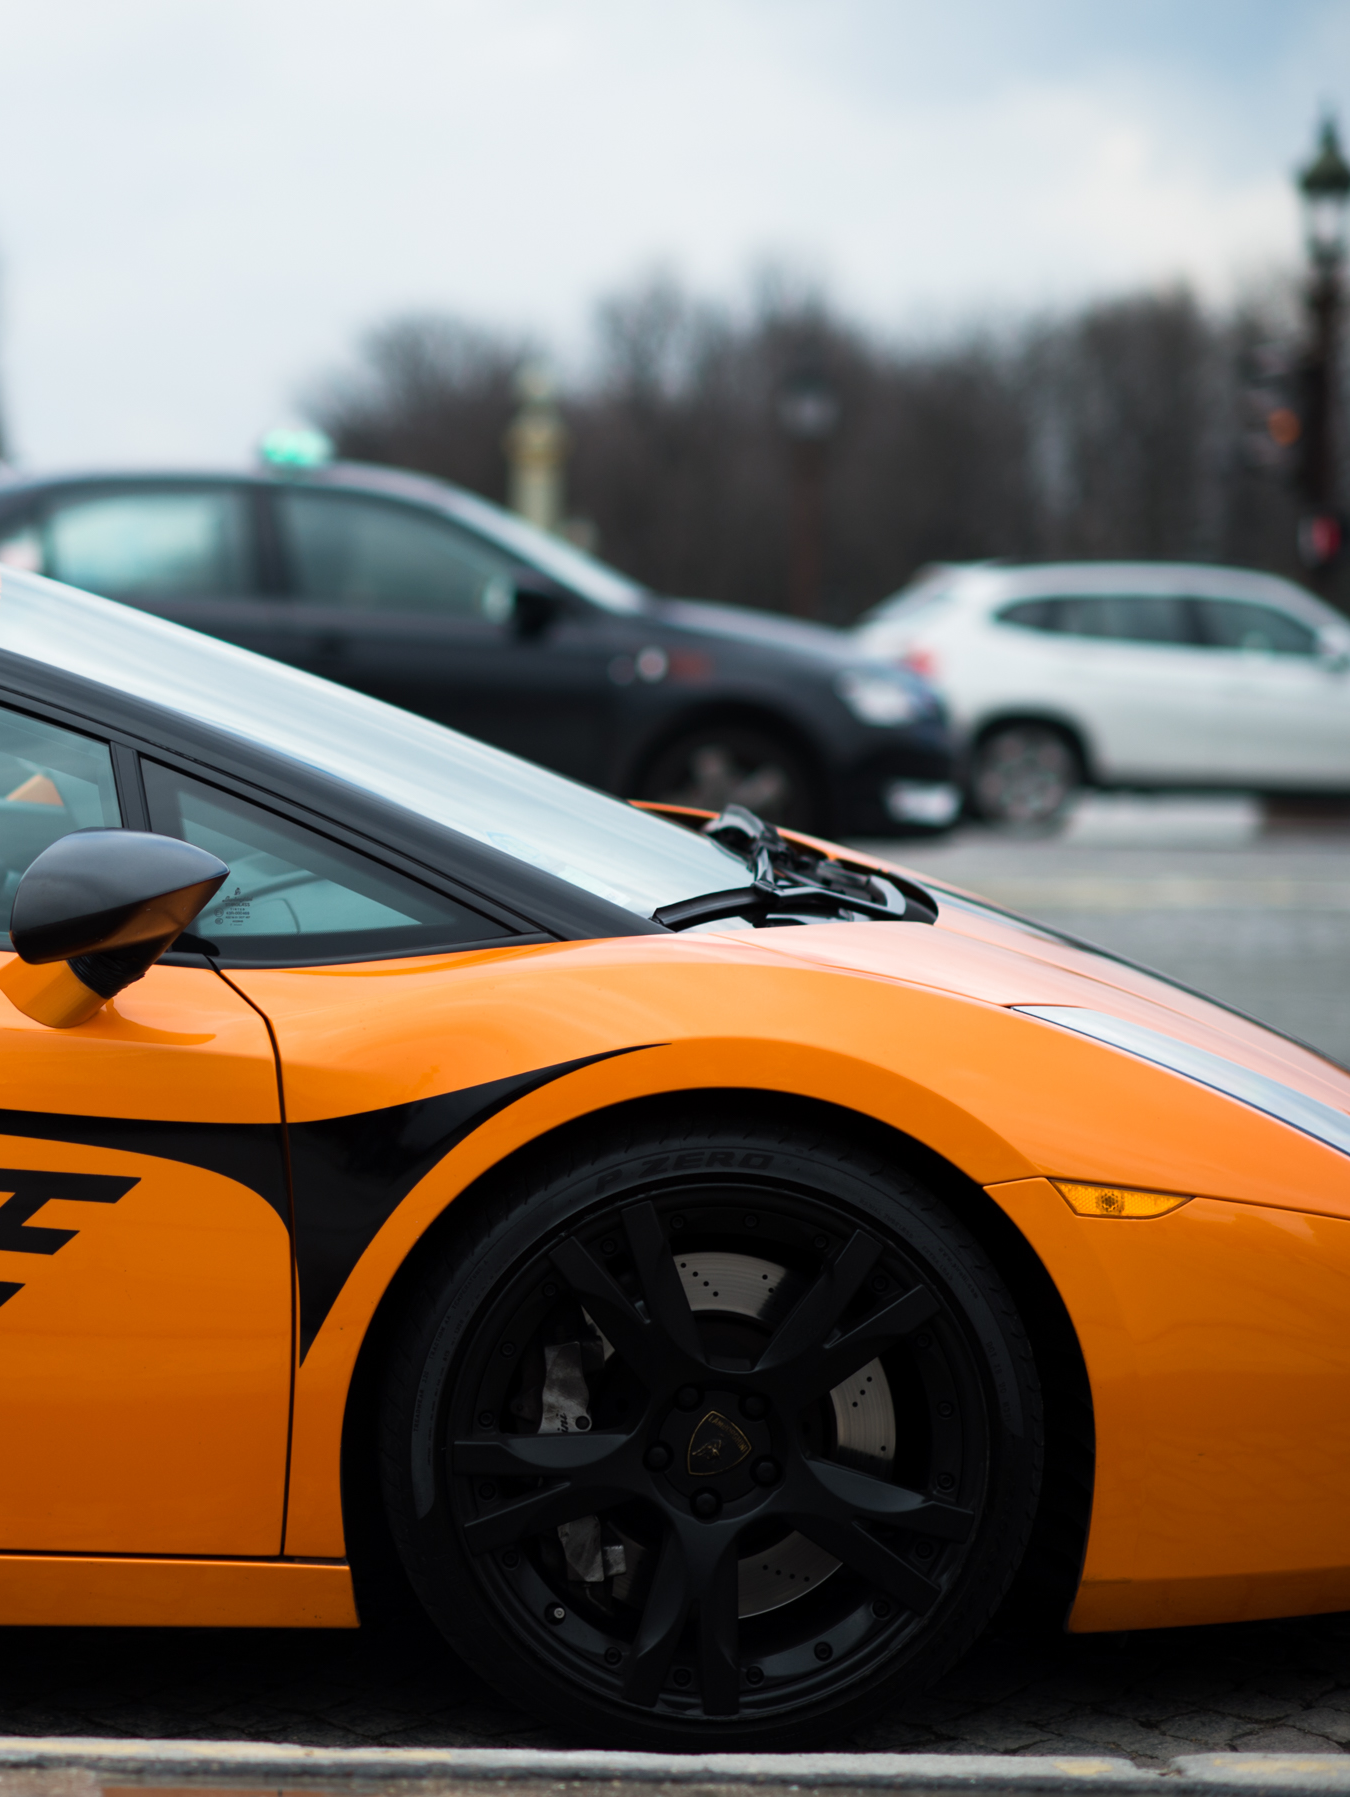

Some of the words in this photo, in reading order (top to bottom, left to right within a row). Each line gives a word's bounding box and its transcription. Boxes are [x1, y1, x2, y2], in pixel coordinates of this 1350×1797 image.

[594, 1168, 623, 1196] P
[638, 1151, 775, 1179] ZERO
[413, 1389, 424, 1432] TREADWEAR
[428, 1326, 446, 1360] TRACTION
[451, 1266, 483, 1310] TEMPERATURE
[985, 1340, 998, 1358] DOT
[707, 1414, 749, 1454] LAMBORGHINI
